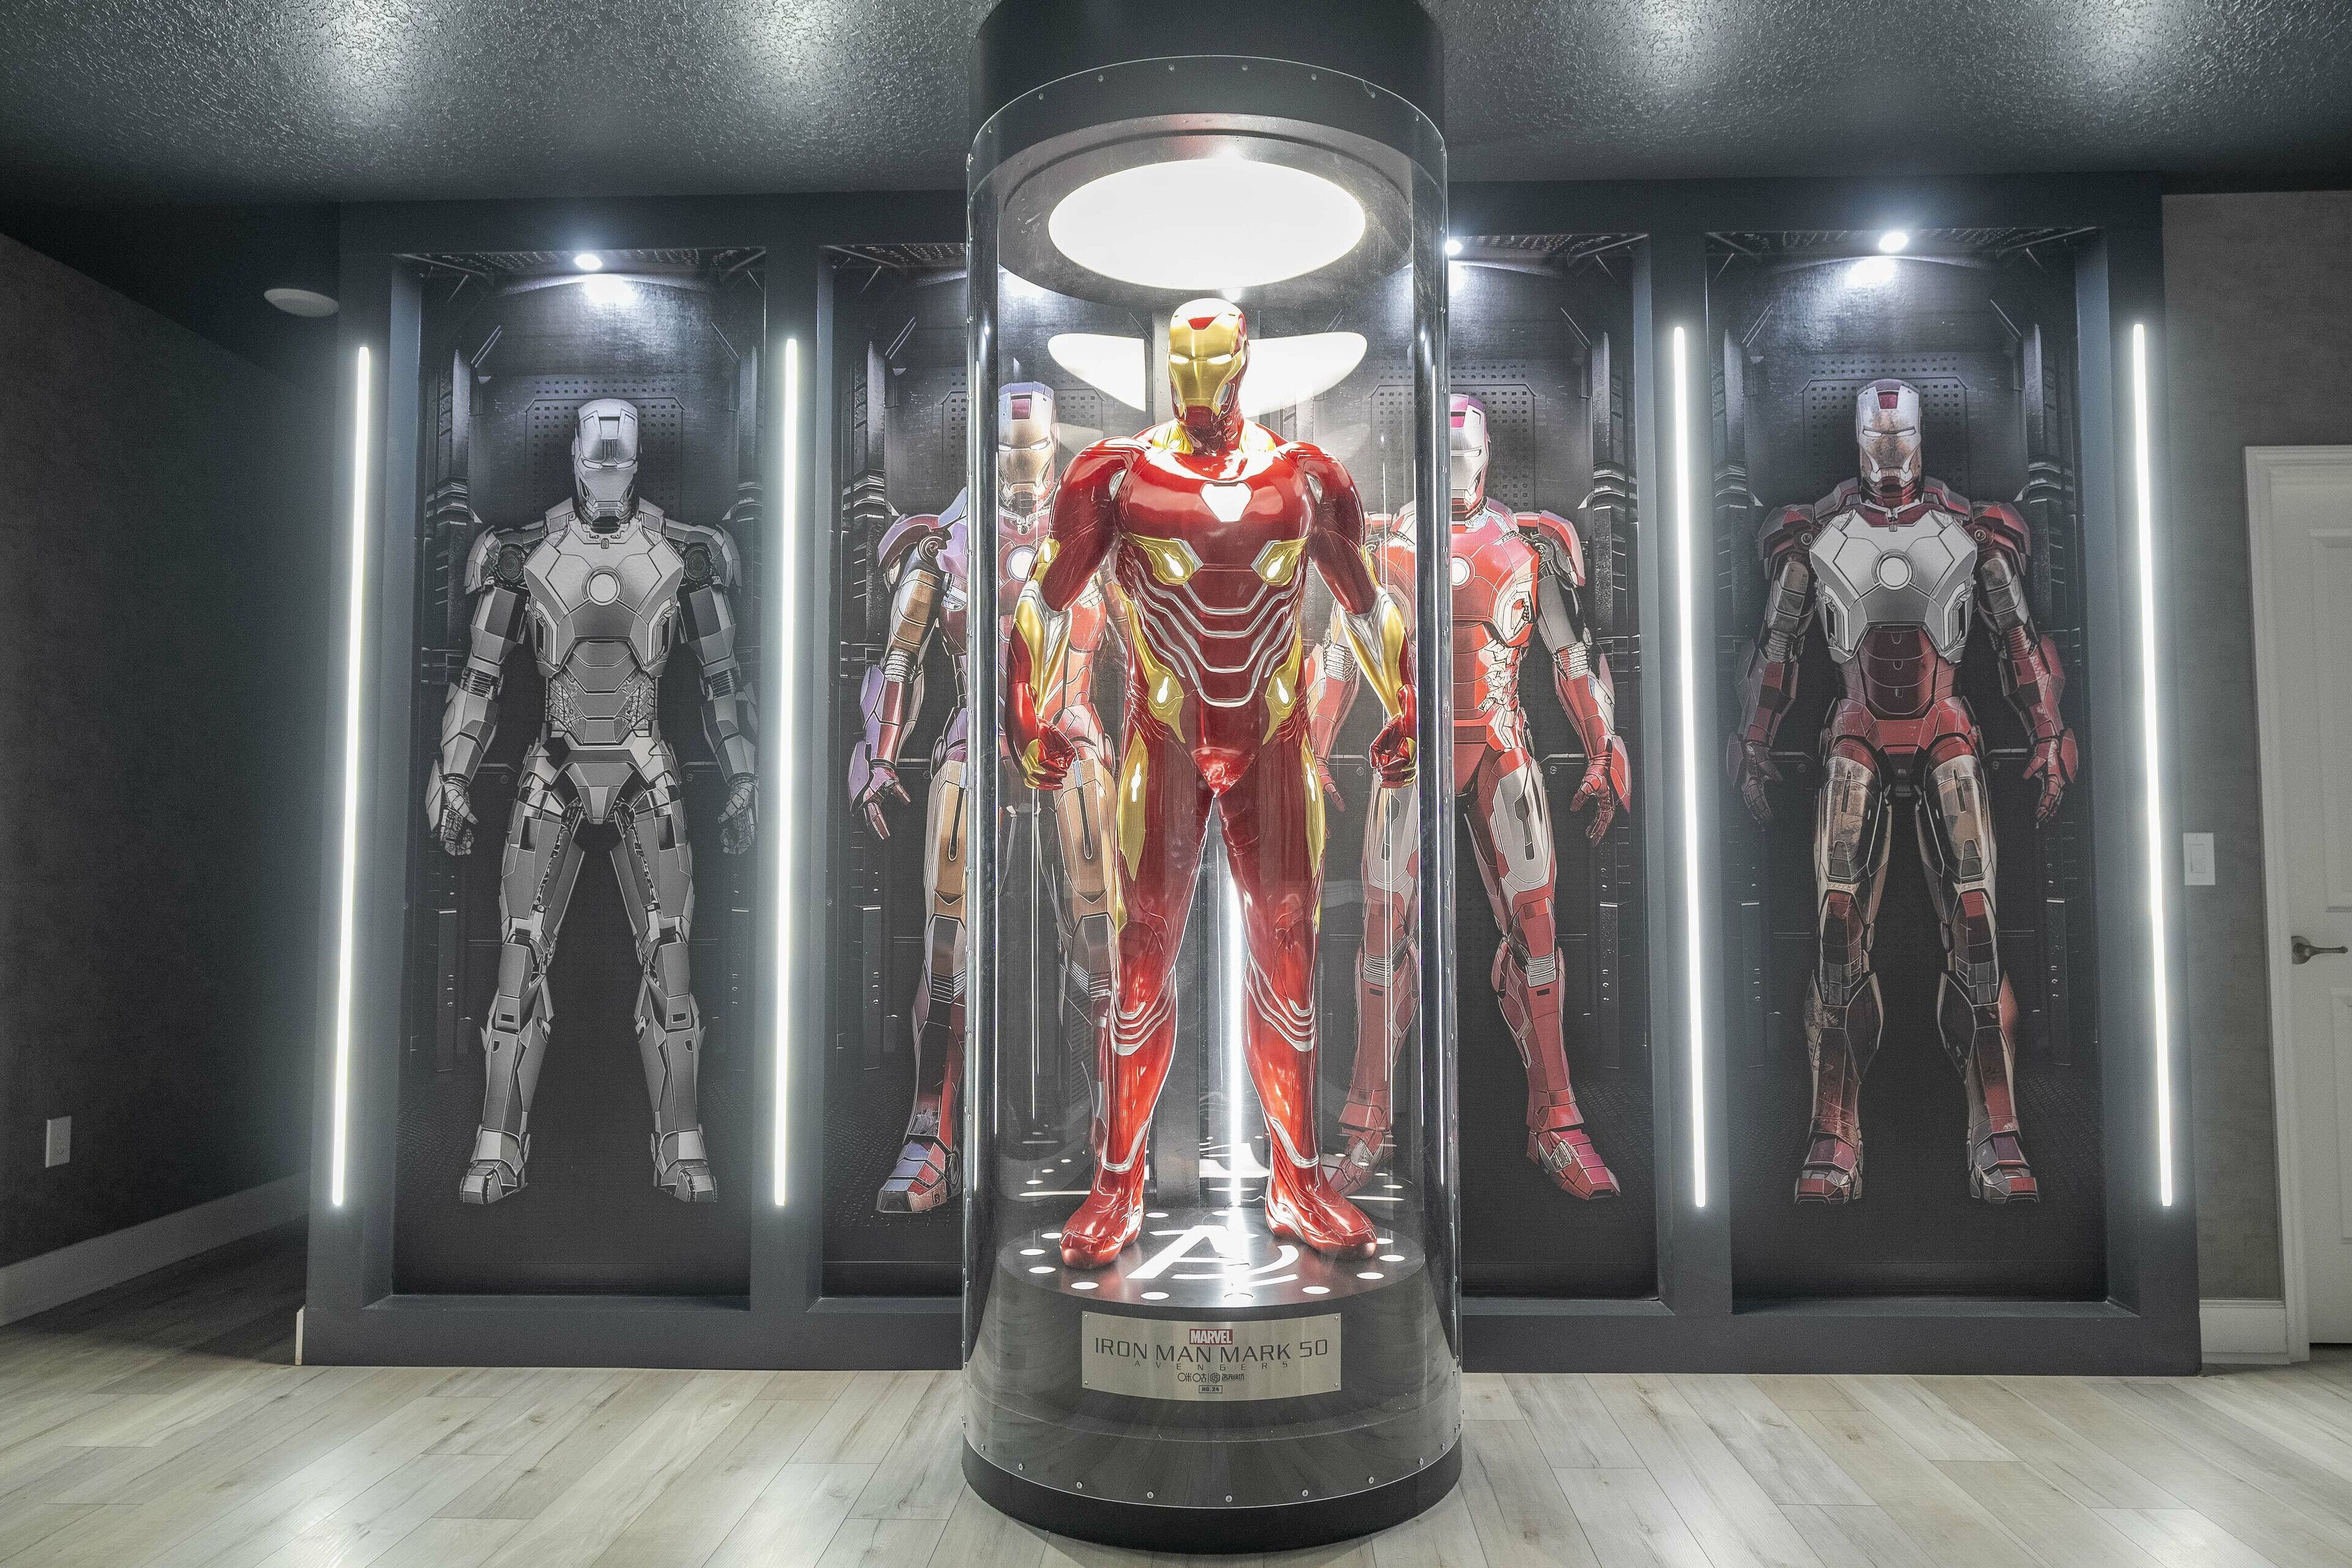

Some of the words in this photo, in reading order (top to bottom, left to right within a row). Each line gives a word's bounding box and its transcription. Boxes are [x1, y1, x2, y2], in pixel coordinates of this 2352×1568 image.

[1190, 1330, 1232, 1344] MARVEL
[1096, 1338, 1147, 1360] IRON
[1156, 1344, 1211, 1363] MAN
[1220, 1343, 1291, 1363] MARK
[1300, 1339, 1328, 1358] 50
[1134, 1360, 1289, 1371] AVENGERS
